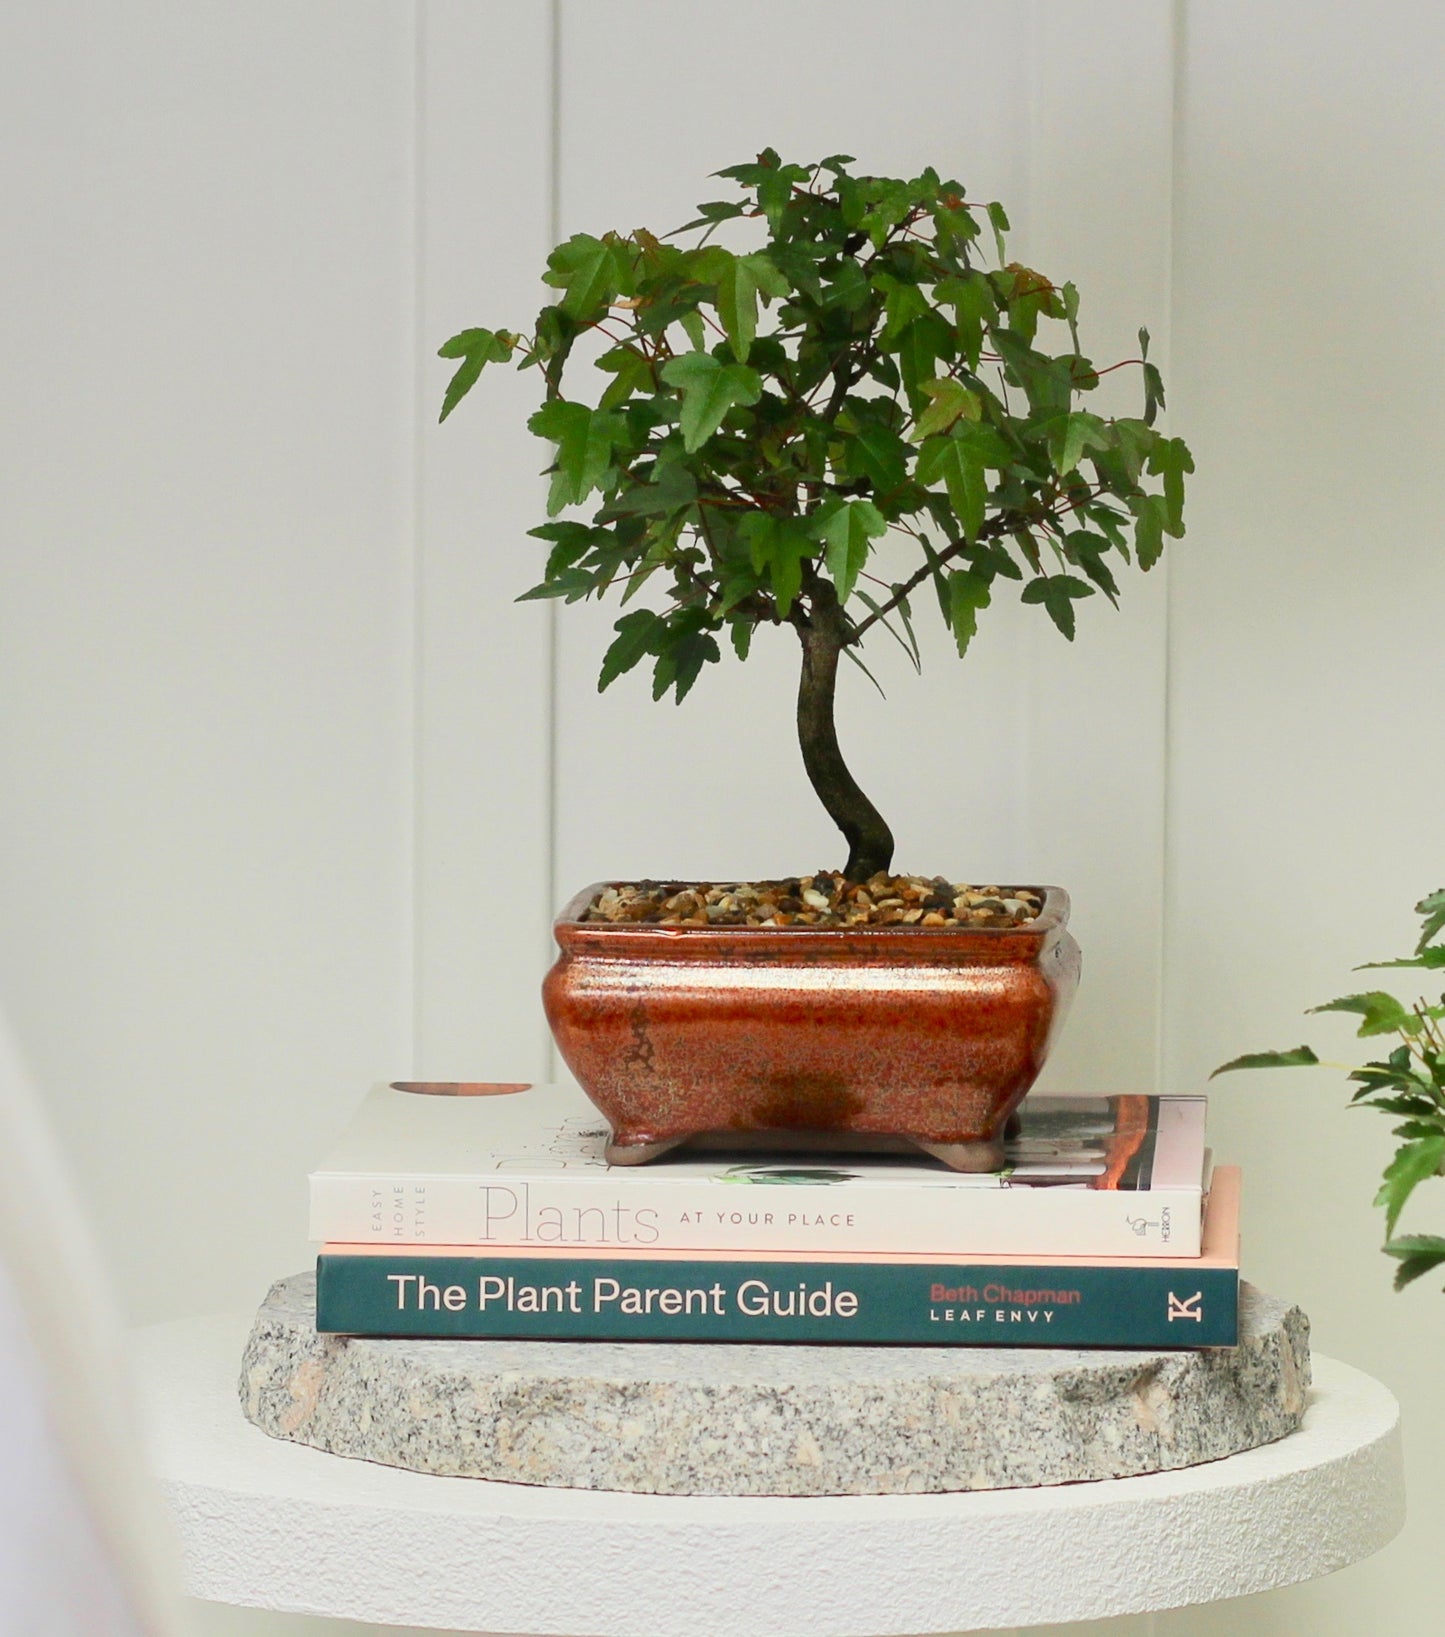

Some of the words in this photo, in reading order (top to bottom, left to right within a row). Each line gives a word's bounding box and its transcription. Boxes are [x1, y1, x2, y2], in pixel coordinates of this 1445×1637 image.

[371, 1189, 383, 1231] EASY
[393, 1185, 404, 1237] HOME
[414, 1185, 426, 1238] STYLE
[479, 1182, 660, 1244] Plants
[680, 1211, 703, 1224] AT
[716, 1212, 775, 1225] YOUR
[788, 1213, 856, 1227] PLACE
[387, 1274, 467, 1310] The
[479, 1276, 583, 1314] Plant
[594, 1278, 726, 1316] Parent
[736, 1279, 859, 1318] Guide
[930, 1284, 979, 1303] Beth
[982, 1284, 1081, 1307] Chapman
[1168, 1291, 1202, 1323] K
